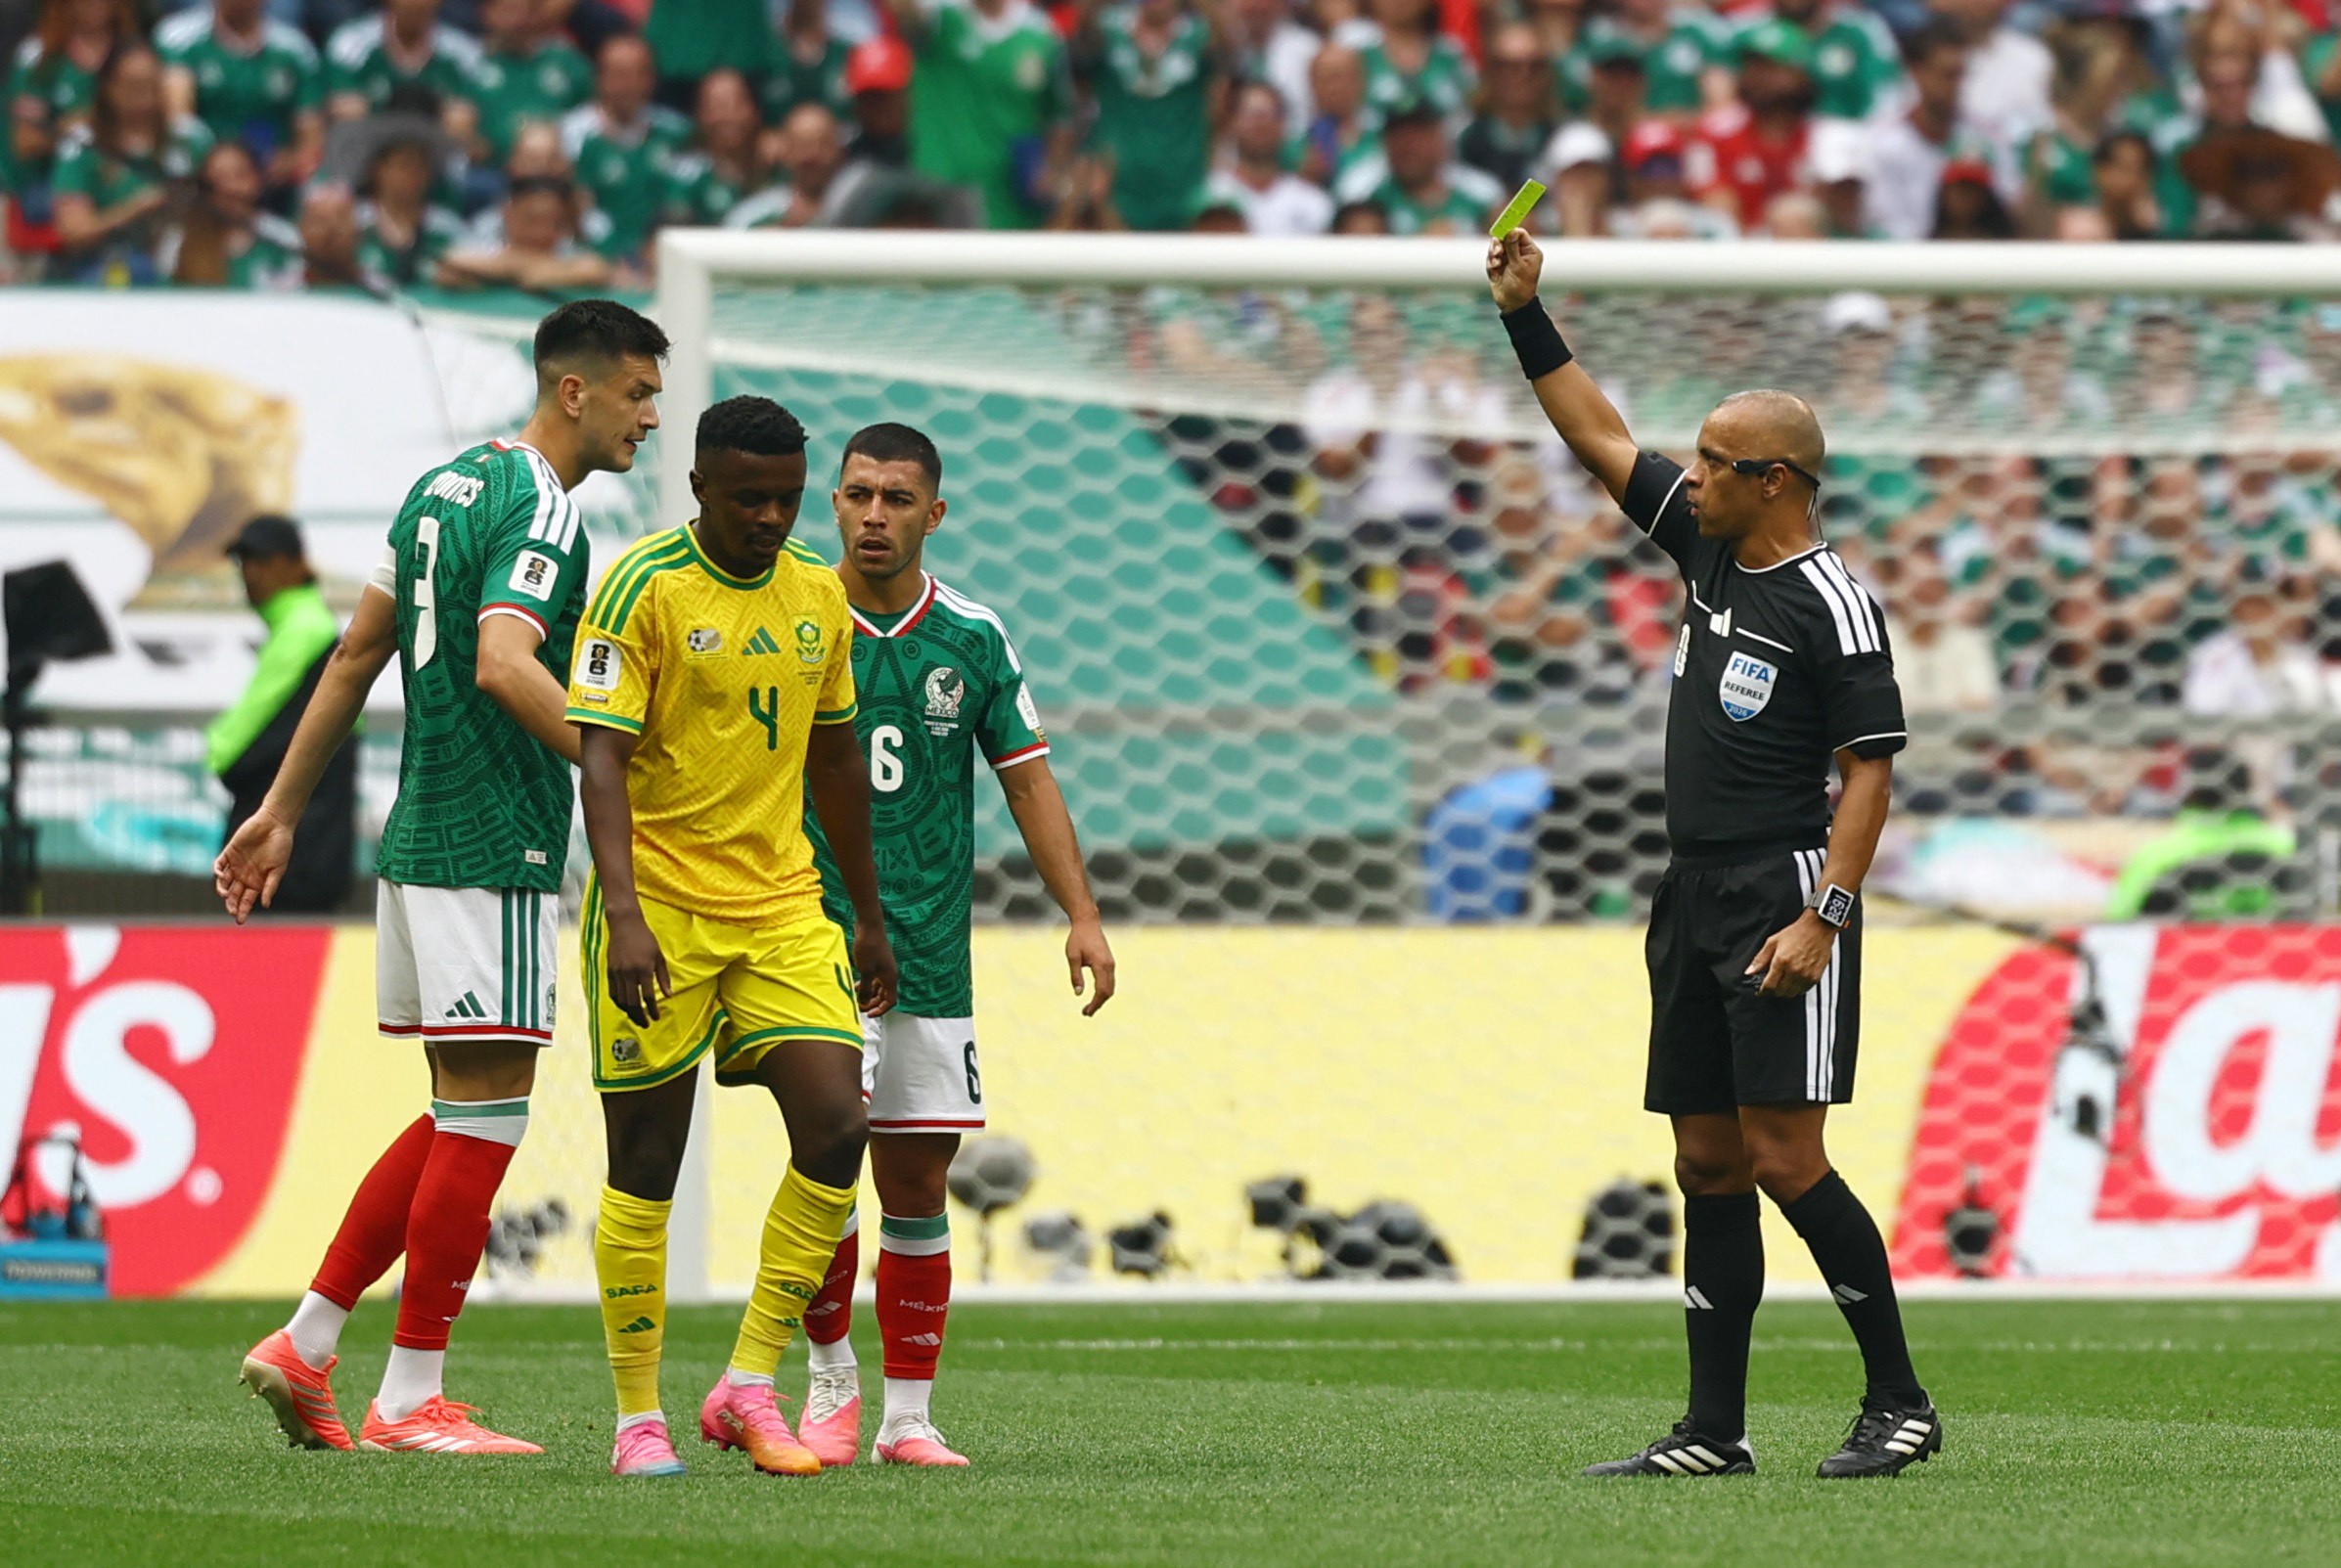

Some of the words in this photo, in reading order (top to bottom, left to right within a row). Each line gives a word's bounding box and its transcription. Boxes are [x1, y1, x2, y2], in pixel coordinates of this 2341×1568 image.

[1724, 680, 1767, 701] REFEREE
[1731, 657, 1770, 684] FIFA
[749, 686, 779, 751] 4
[1728, 704, 1748, 716] 2026
[871, 725, 904, 792] 6
[833, 962, 860, 1025] 4
[964, 1040, 981, 1104] 6
[606, 1283, 657, 1299] SAFA
